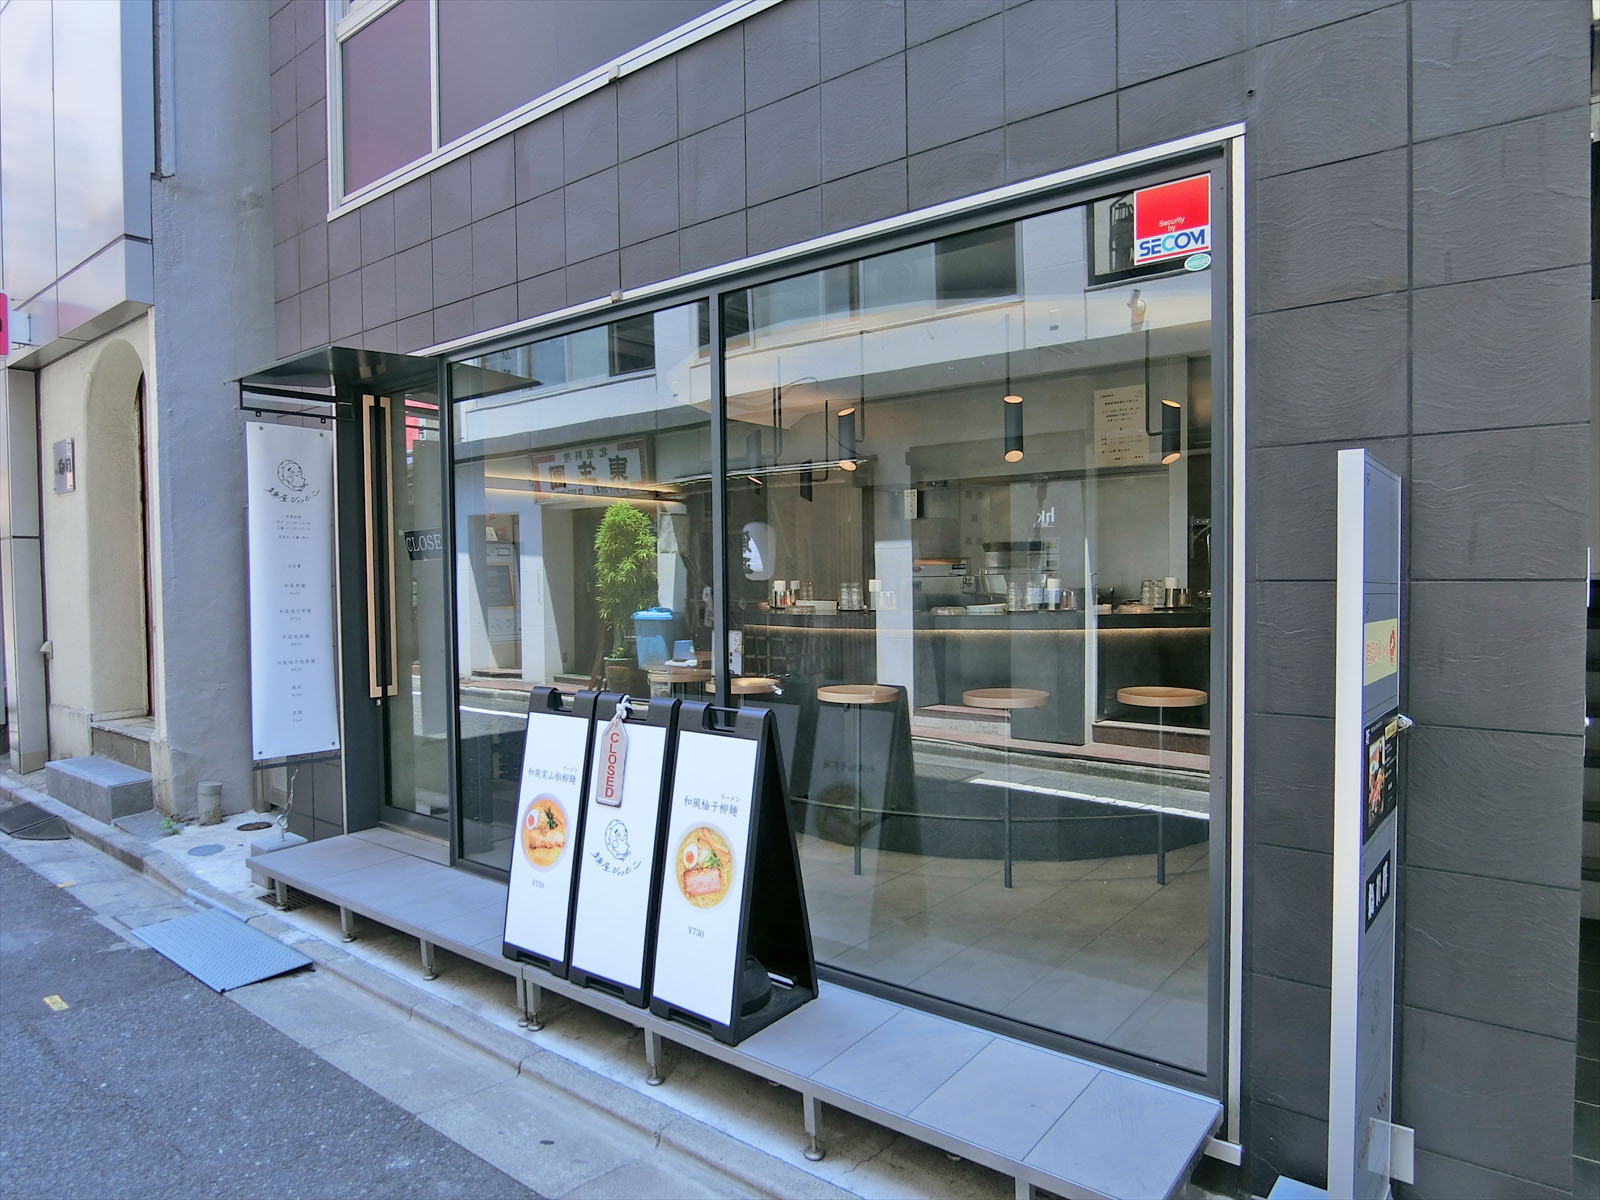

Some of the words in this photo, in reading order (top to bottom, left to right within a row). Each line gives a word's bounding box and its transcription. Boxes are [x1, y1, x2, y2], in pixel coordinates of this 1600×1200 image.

[1159, 217, 1185, 227] Security
[1167, 225, 1176, 233] by
[1139, 229, 1205, 257] SECOM
[604, 732, 620, 798] CLOSED
[688, 925, 705, 938] ¥730
